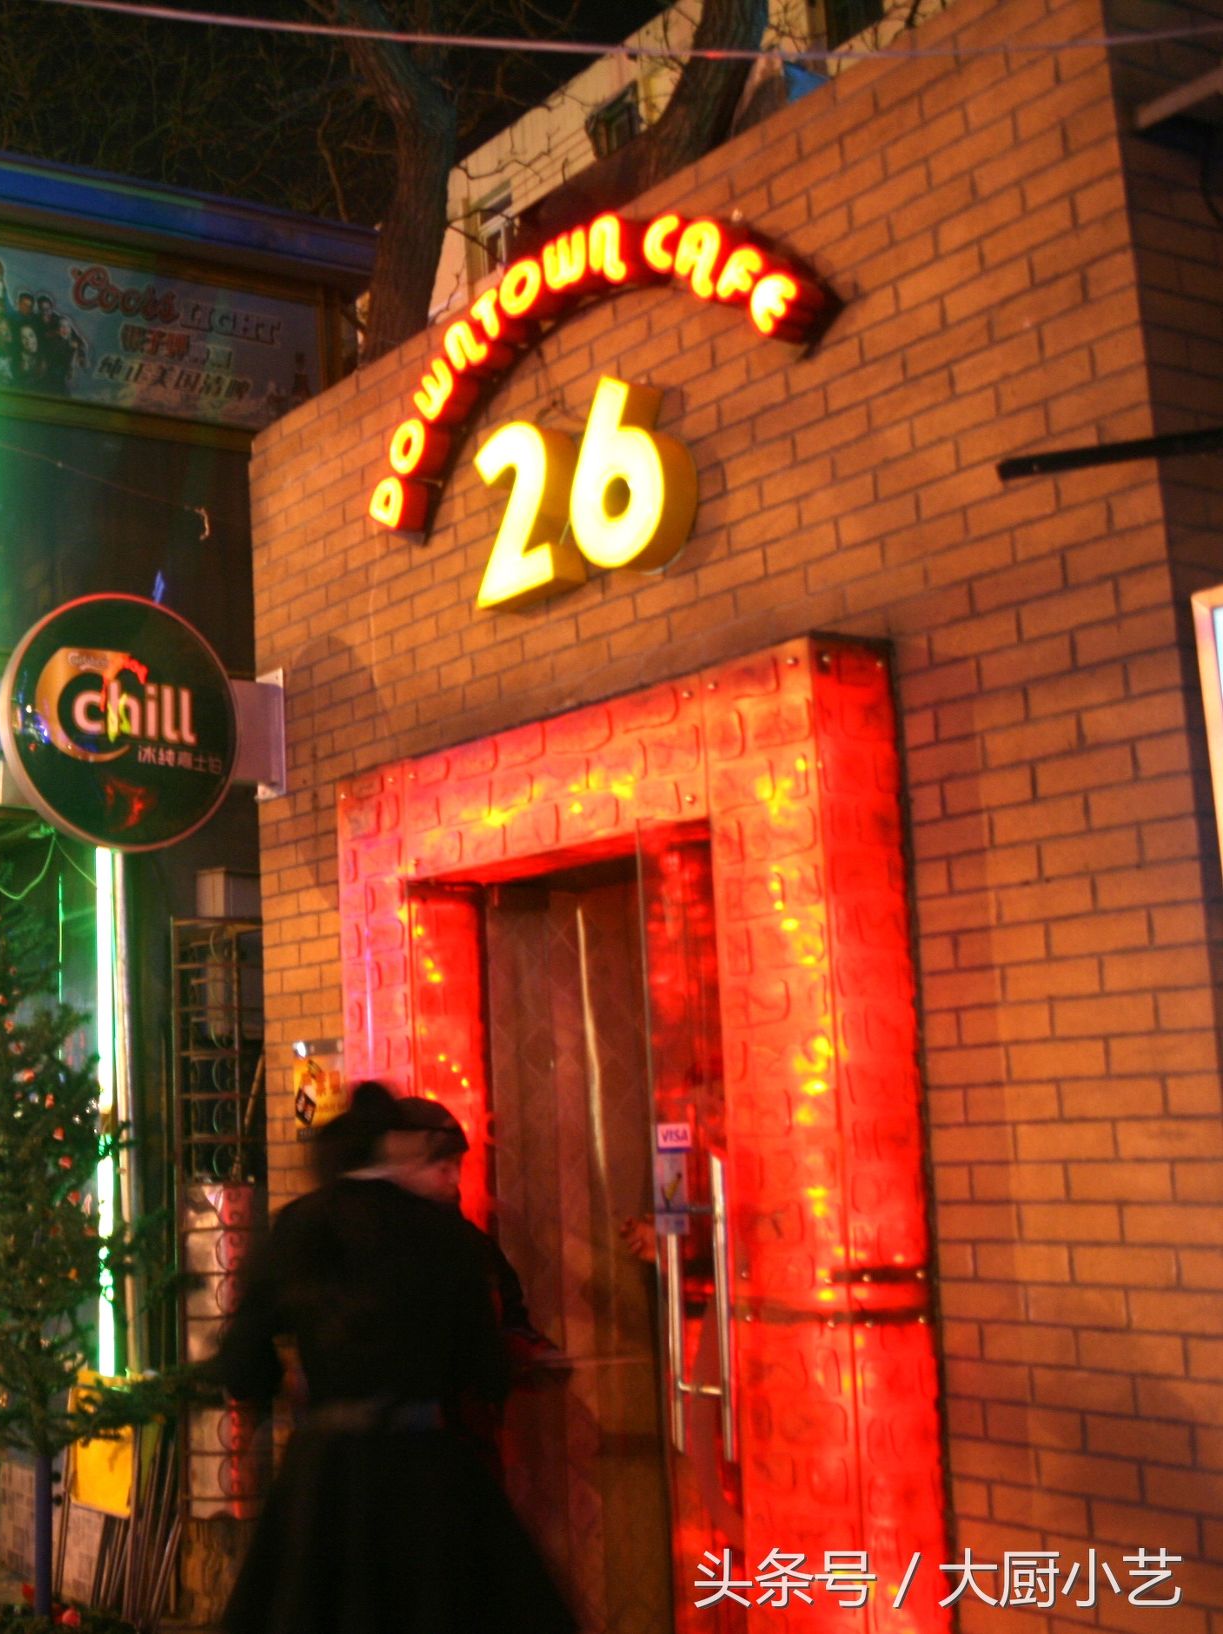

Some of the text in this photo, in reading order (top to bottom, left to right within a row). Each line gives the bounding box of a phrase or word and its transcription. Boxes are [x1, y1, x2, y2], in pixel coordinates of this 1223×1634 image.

[369, 212, 797, 529] DOWNTOWN CAFE
[474, 374, 665, 609] 26
[661, 1128, 689, 1142] VISA
